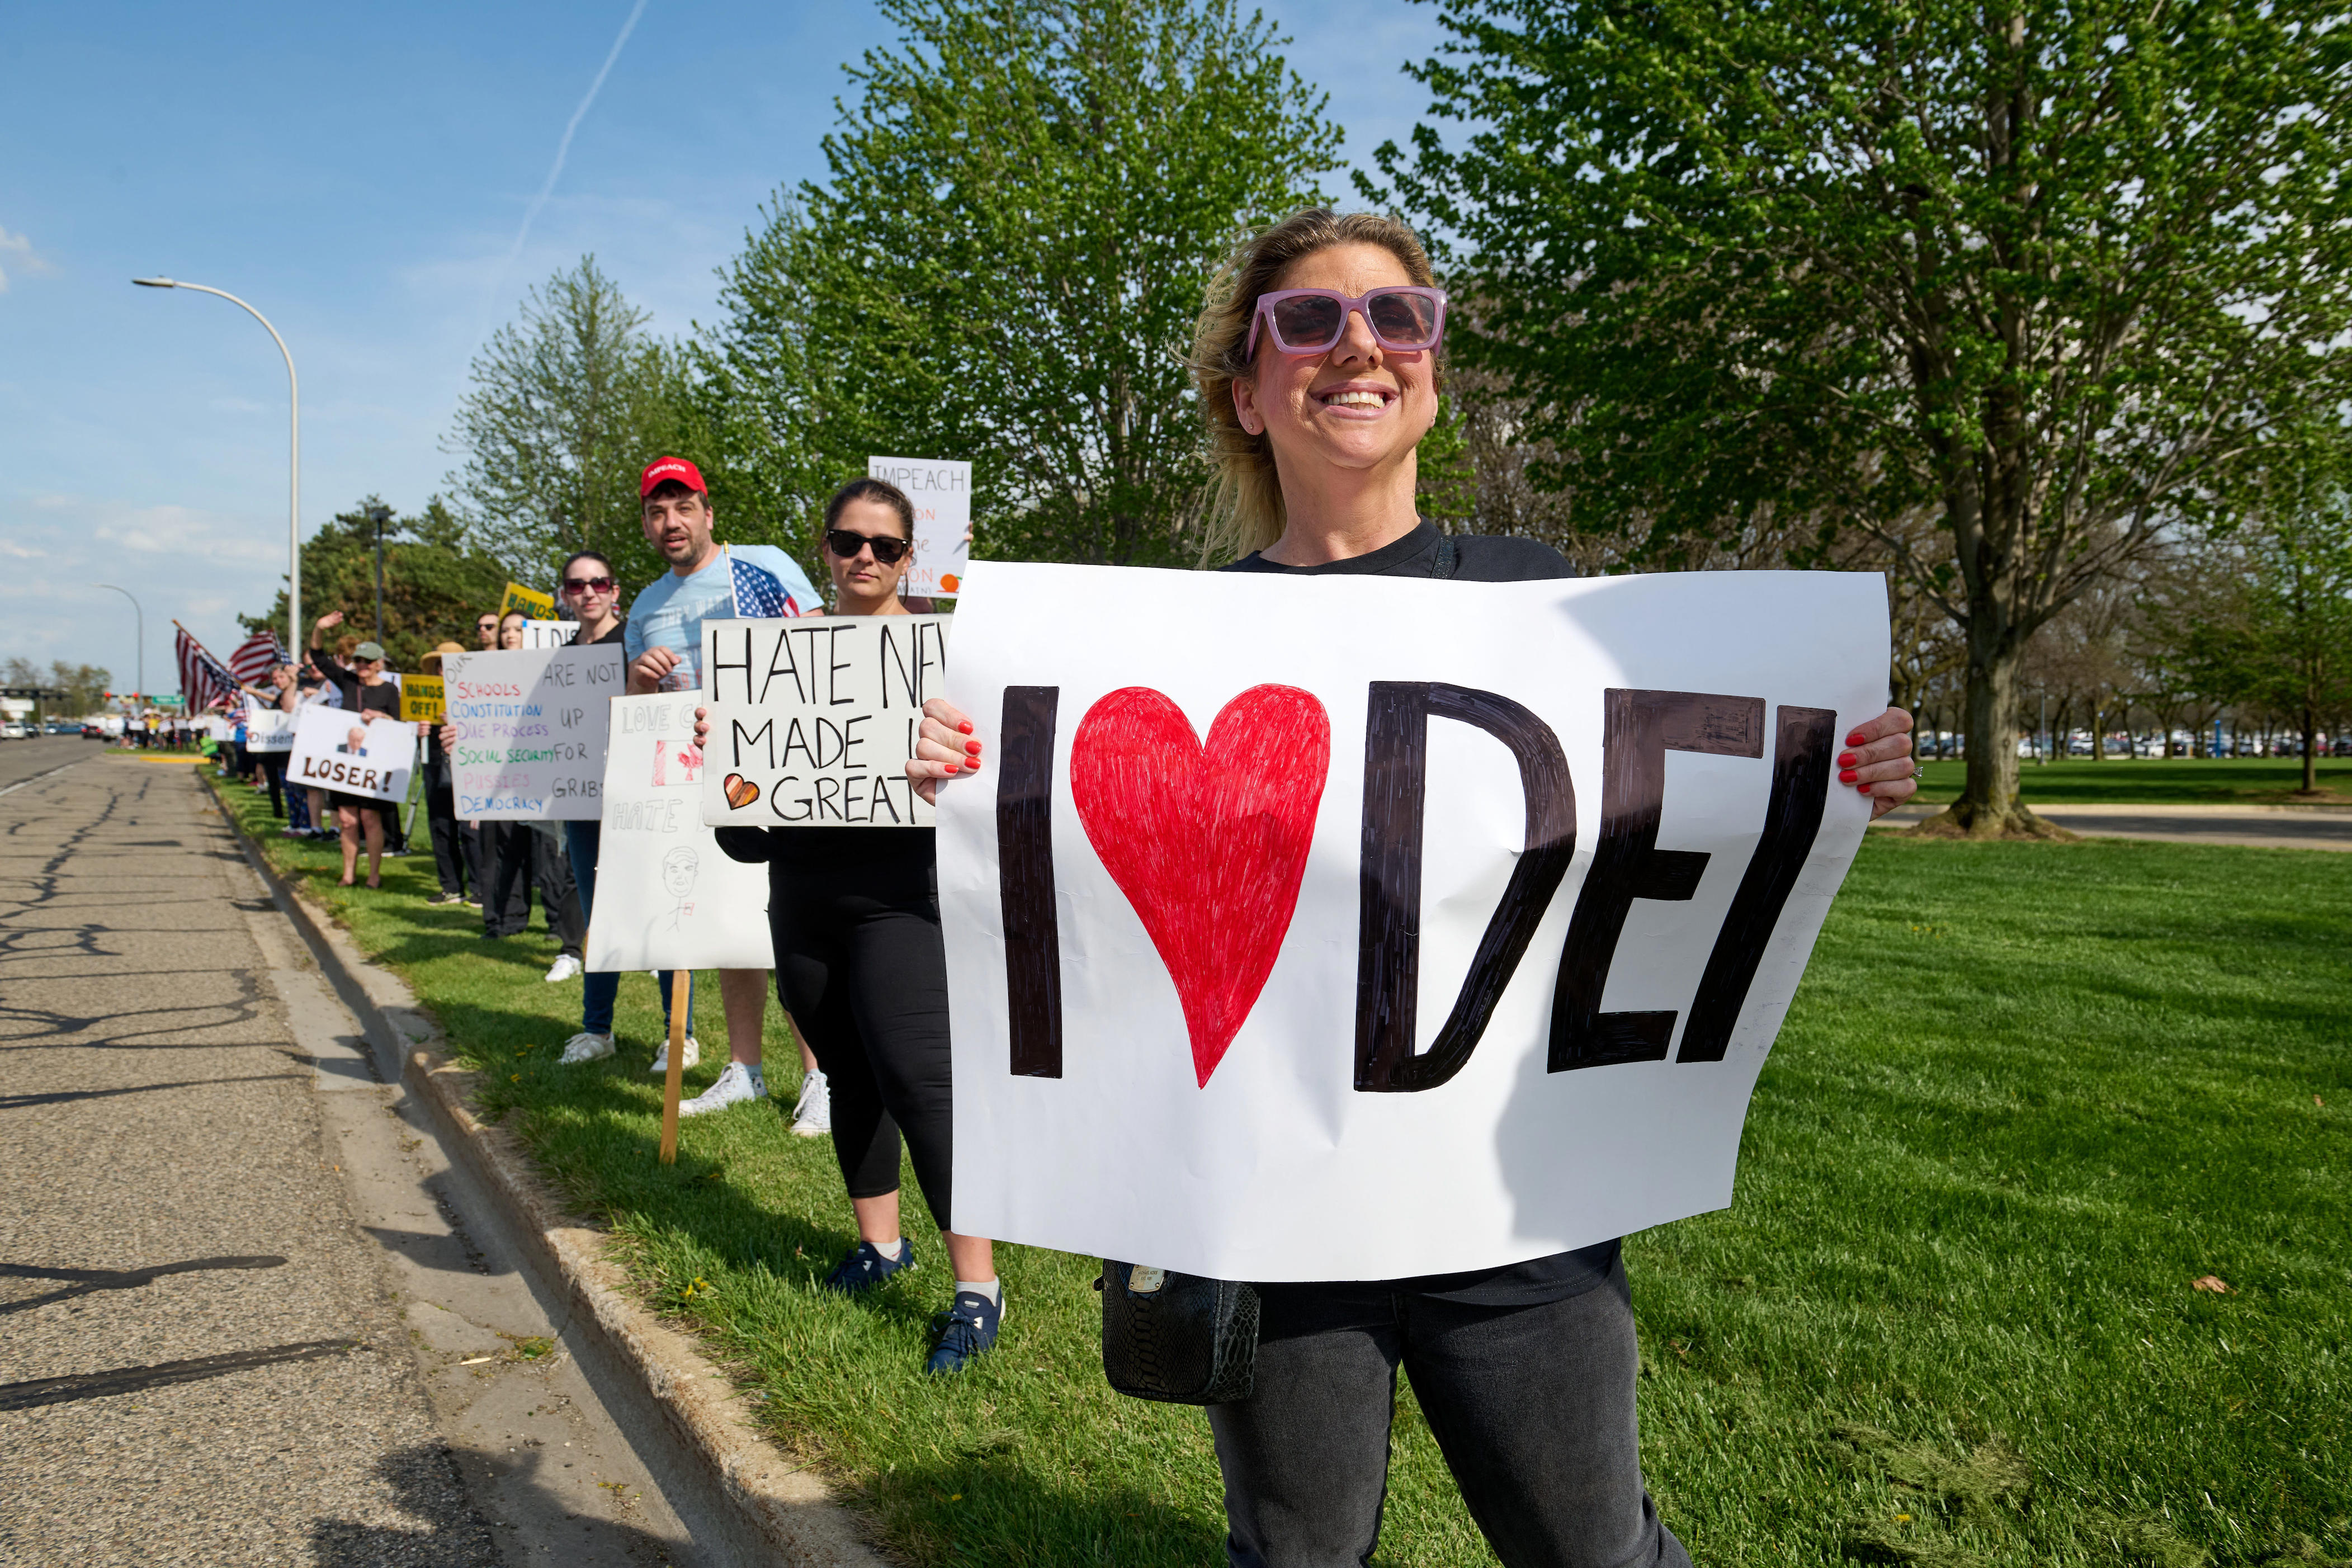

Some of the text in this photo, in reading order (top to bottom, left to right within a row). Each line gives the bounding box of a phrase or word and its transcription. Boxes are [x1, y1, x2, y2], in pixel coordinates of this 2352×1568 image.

[648, 464, 686, 478] IMPEACH
[873, 465, 964, 492] IMPEACH
[508, 593, 555, 620] HANDS
[446, 655, 473, 684] OUR
[542, 663, 619, 687] ARE NOT
[713, 625, 857, 706] HATE
[407, 683, 443, 698] HANDS
[457, 682, 521, 698] SCHOOLS
[410, 701, 437, 719] OFF!
[451, 701, 542, 718] CONSTITUTION
[561, 708, 584, 728] UP
[622, 704, 671, 734] LOVE
[456, 721, 549, 740] DUE PROCESS
[554, 743, 588, 761] FOR
[733, 715, 872, 769] MADE
[457, 747, 554, 766] SOCIAL SECURITY
[464, 772, 530, 790] PUSSIES
[461, 795, 542, 814] DEMOCRACY
[771, 776, 915, 825] GREAT
[612, 799, 683, 833] HATE
[998, 681, 1836, 1092] I DEI
